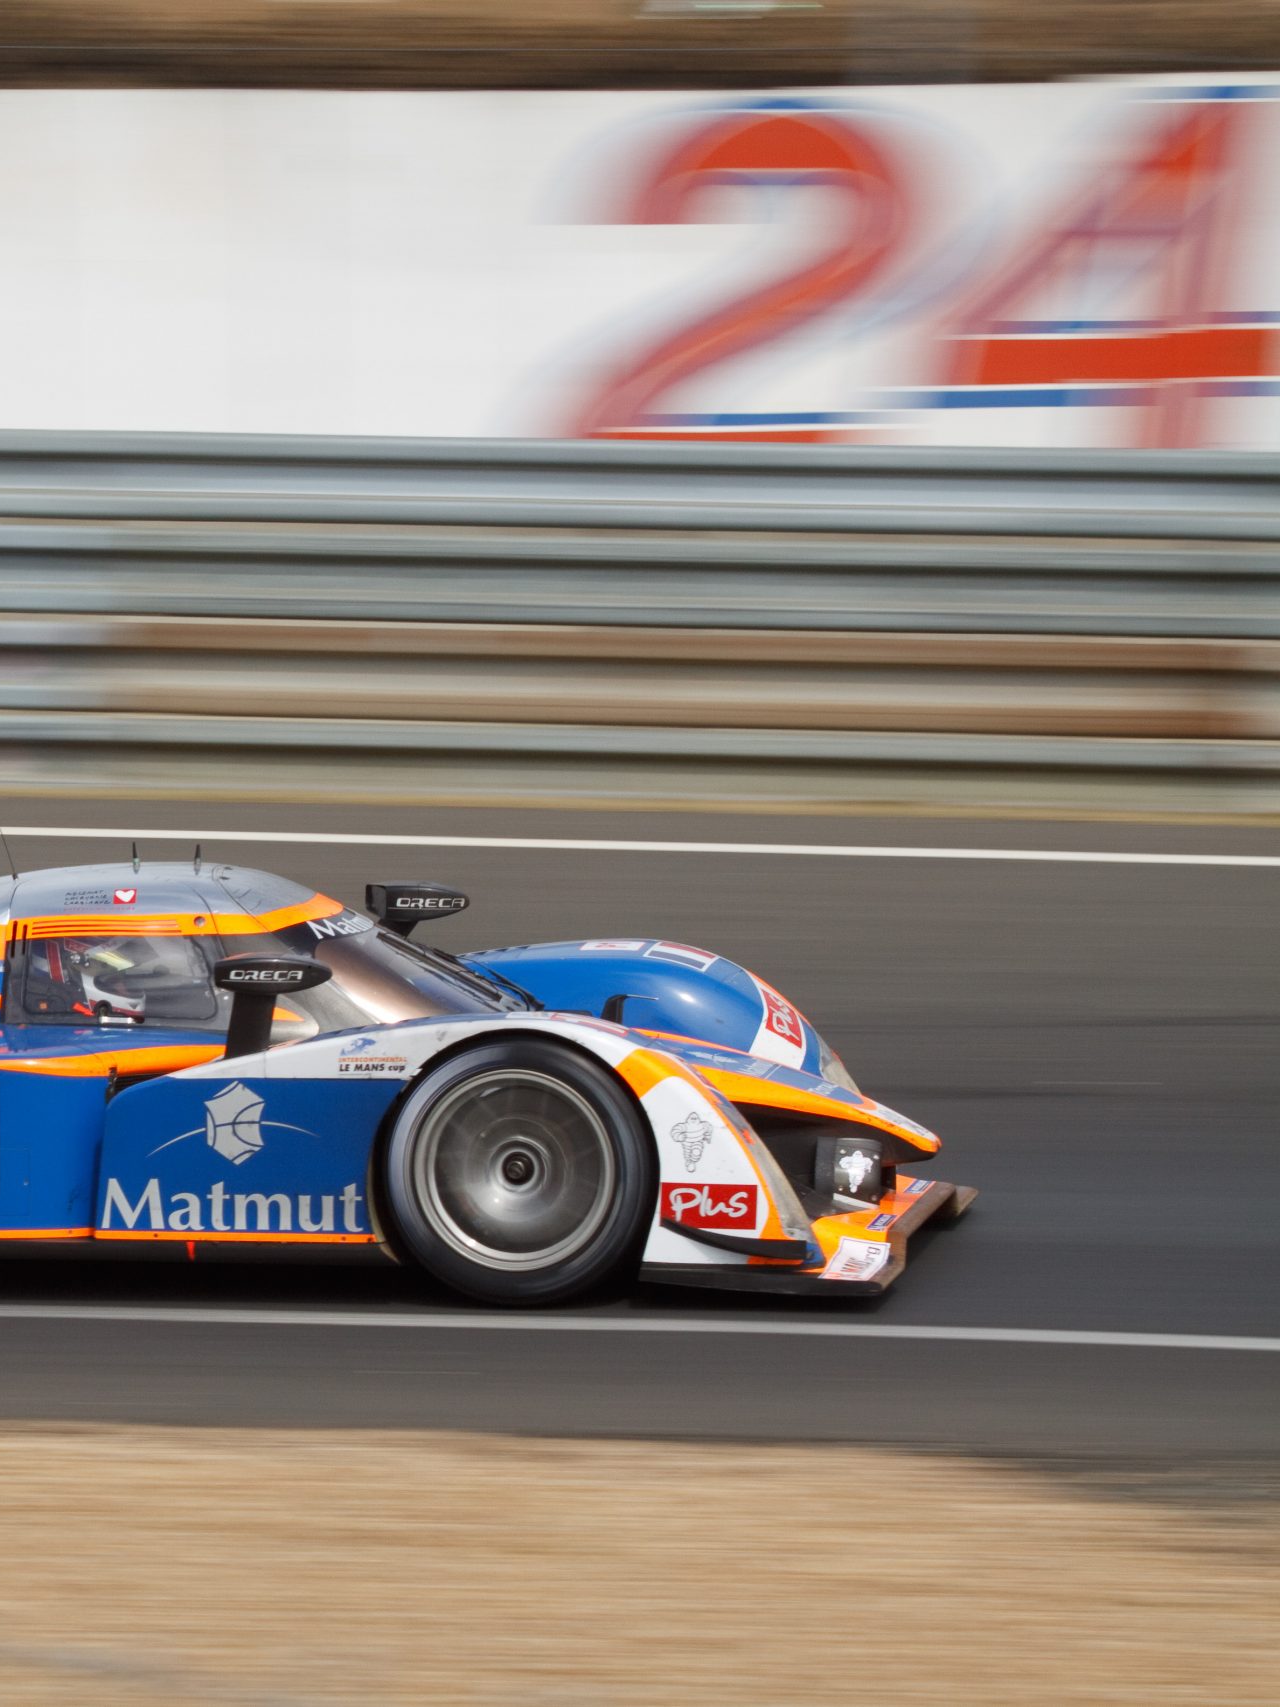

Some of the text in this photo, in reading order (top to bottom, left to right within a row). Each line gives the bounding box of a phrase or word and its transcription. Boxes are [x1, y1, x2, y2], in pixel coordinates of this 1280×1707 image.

[545, 88, 1280, 447] 24
[339, 1063, 406, 1073] LE MANS cup
[101, 1177, 364, 1232] Matmut
[668, 1185, 749, 1222] Plus
